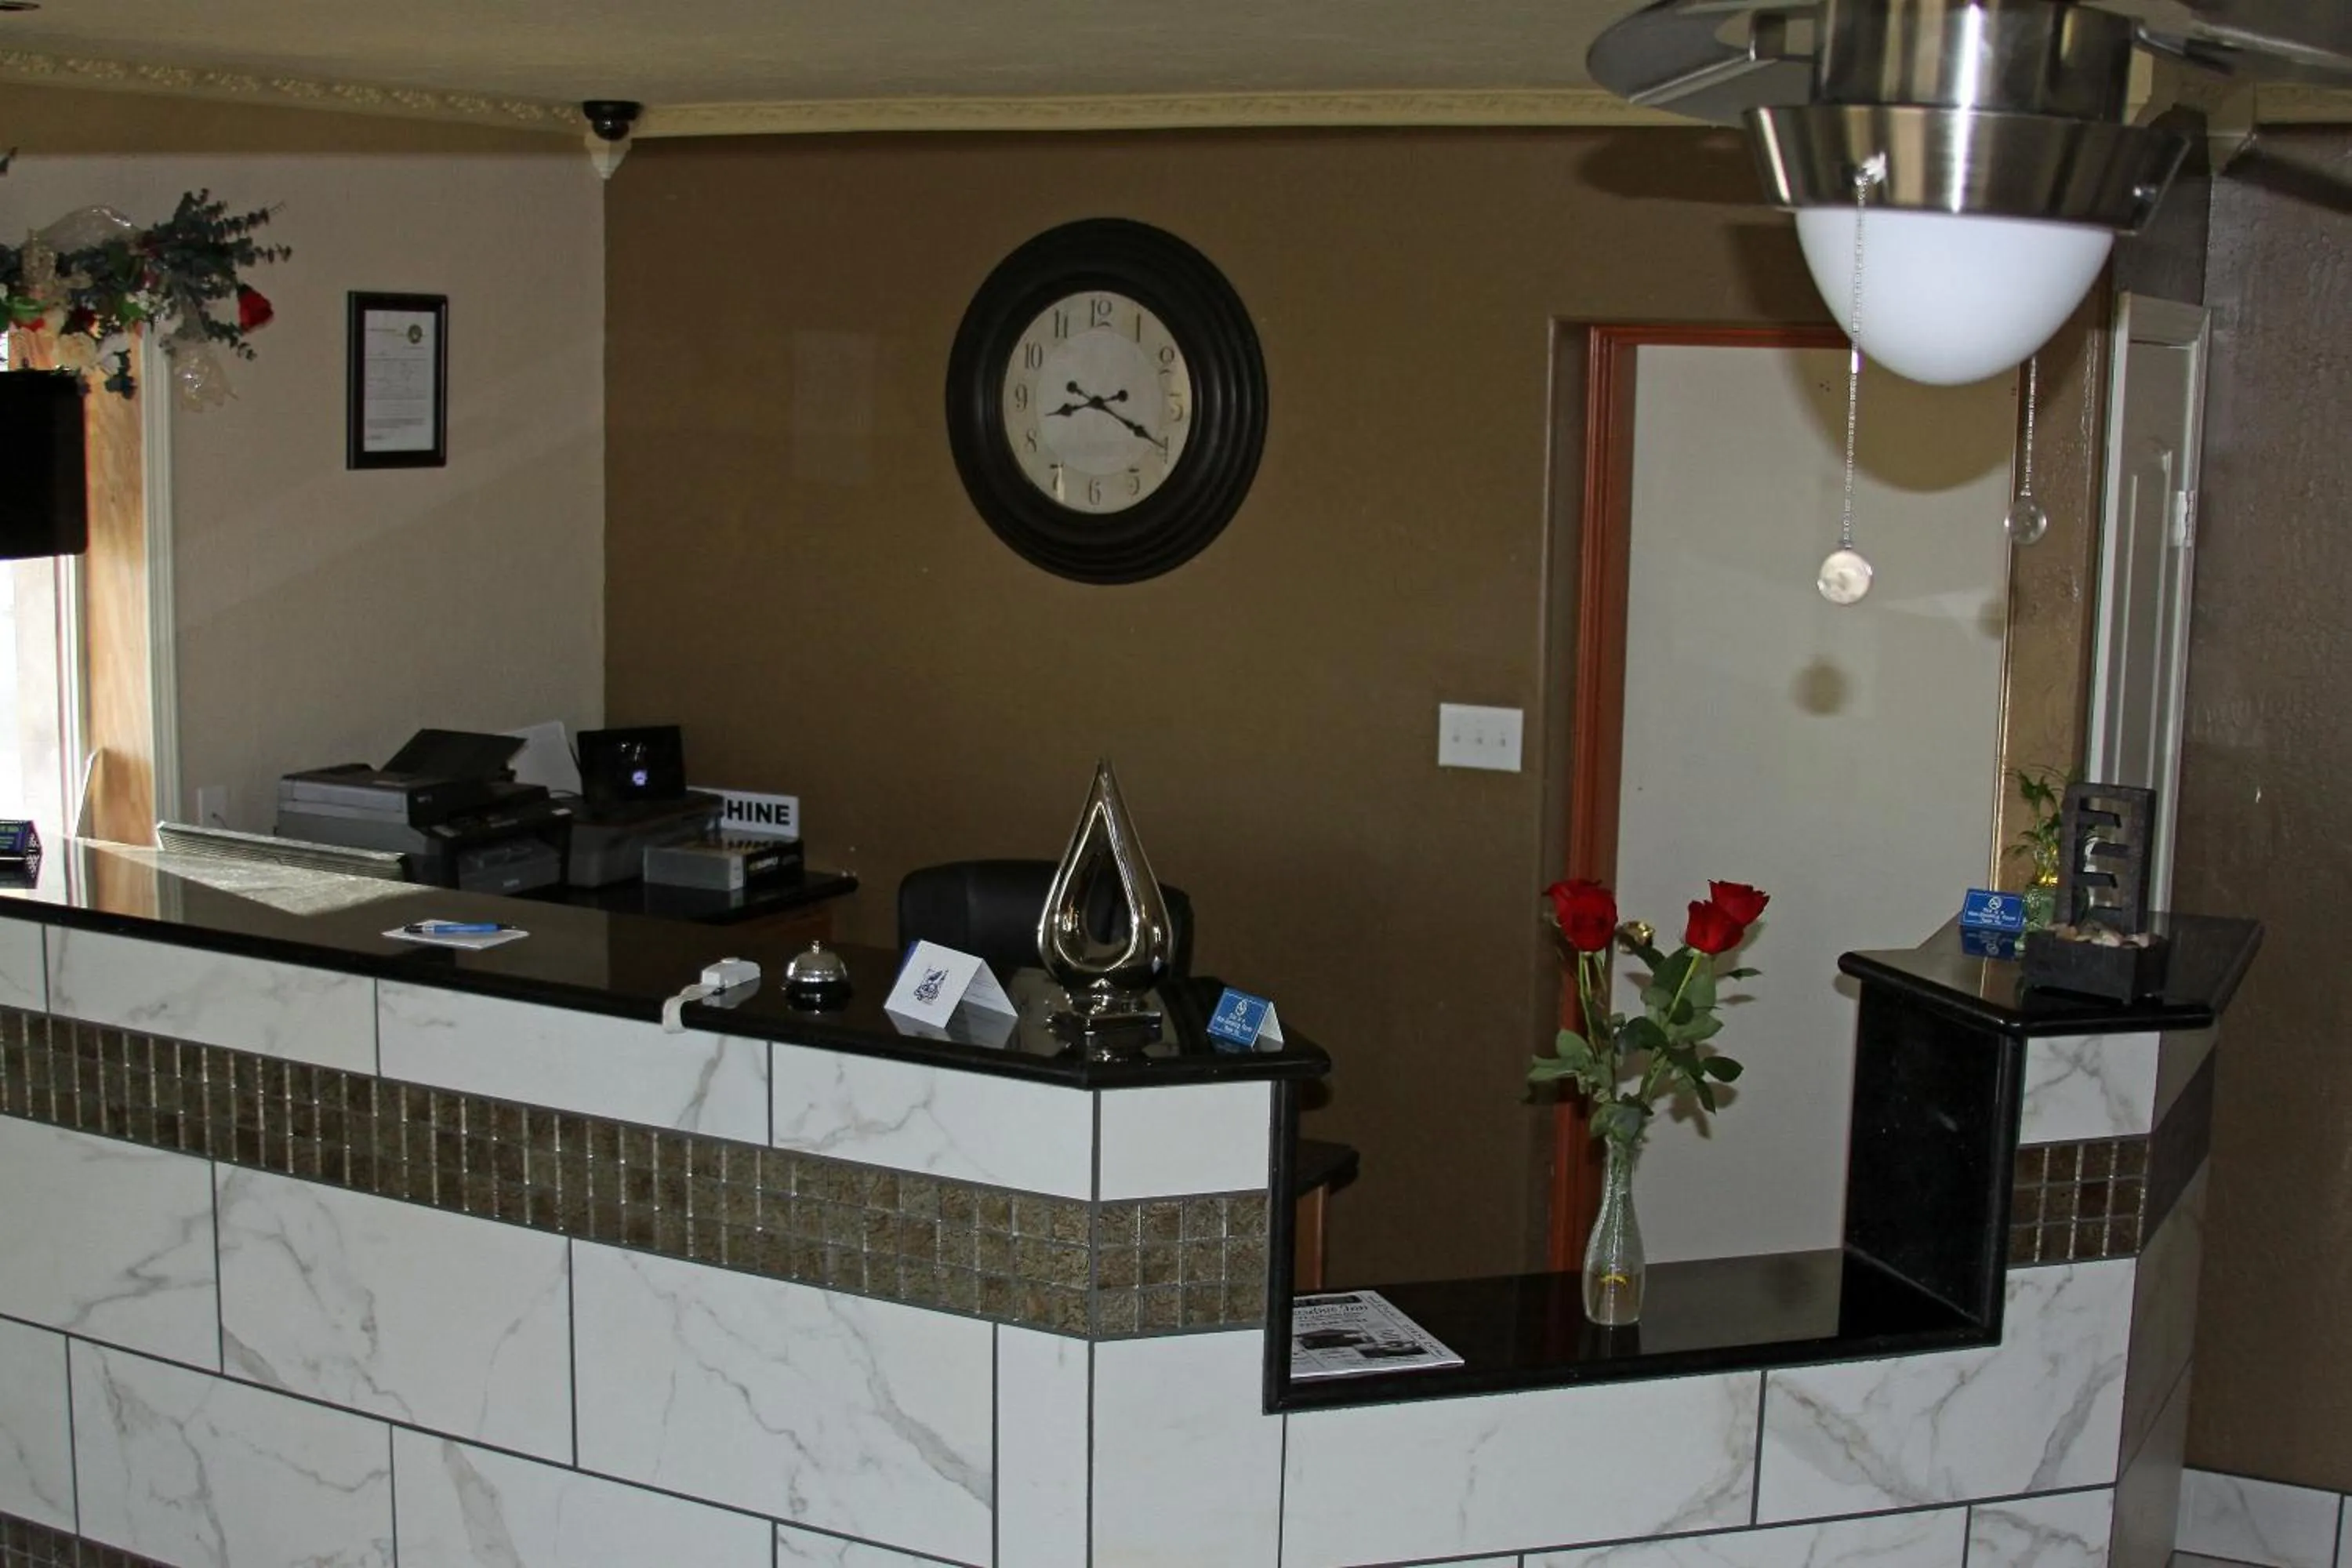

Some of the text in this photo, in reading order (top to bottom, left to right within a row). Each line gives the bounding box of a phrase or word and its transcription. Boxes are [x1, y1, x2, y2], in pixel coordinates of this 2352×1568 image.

[1054, 310, 1069, 339] 11
[1090, 299, 1112, 328] 12
[1135, 313, 1142, 343] 1
[1024, 343, 1044, 370] 10
[1159, 346, 1174, 375] 2
[1014, 383, 1028, 412] 9
[1168, 392, 1184, 423] 3
[1025, 428, 1038, 452] 8
[1049, 462, 1064, 492] 7
[1088, 478, 1102, 505] 6
[1128, 467, 1141, 496] 5
[727, 799, 791, 826] HINE
